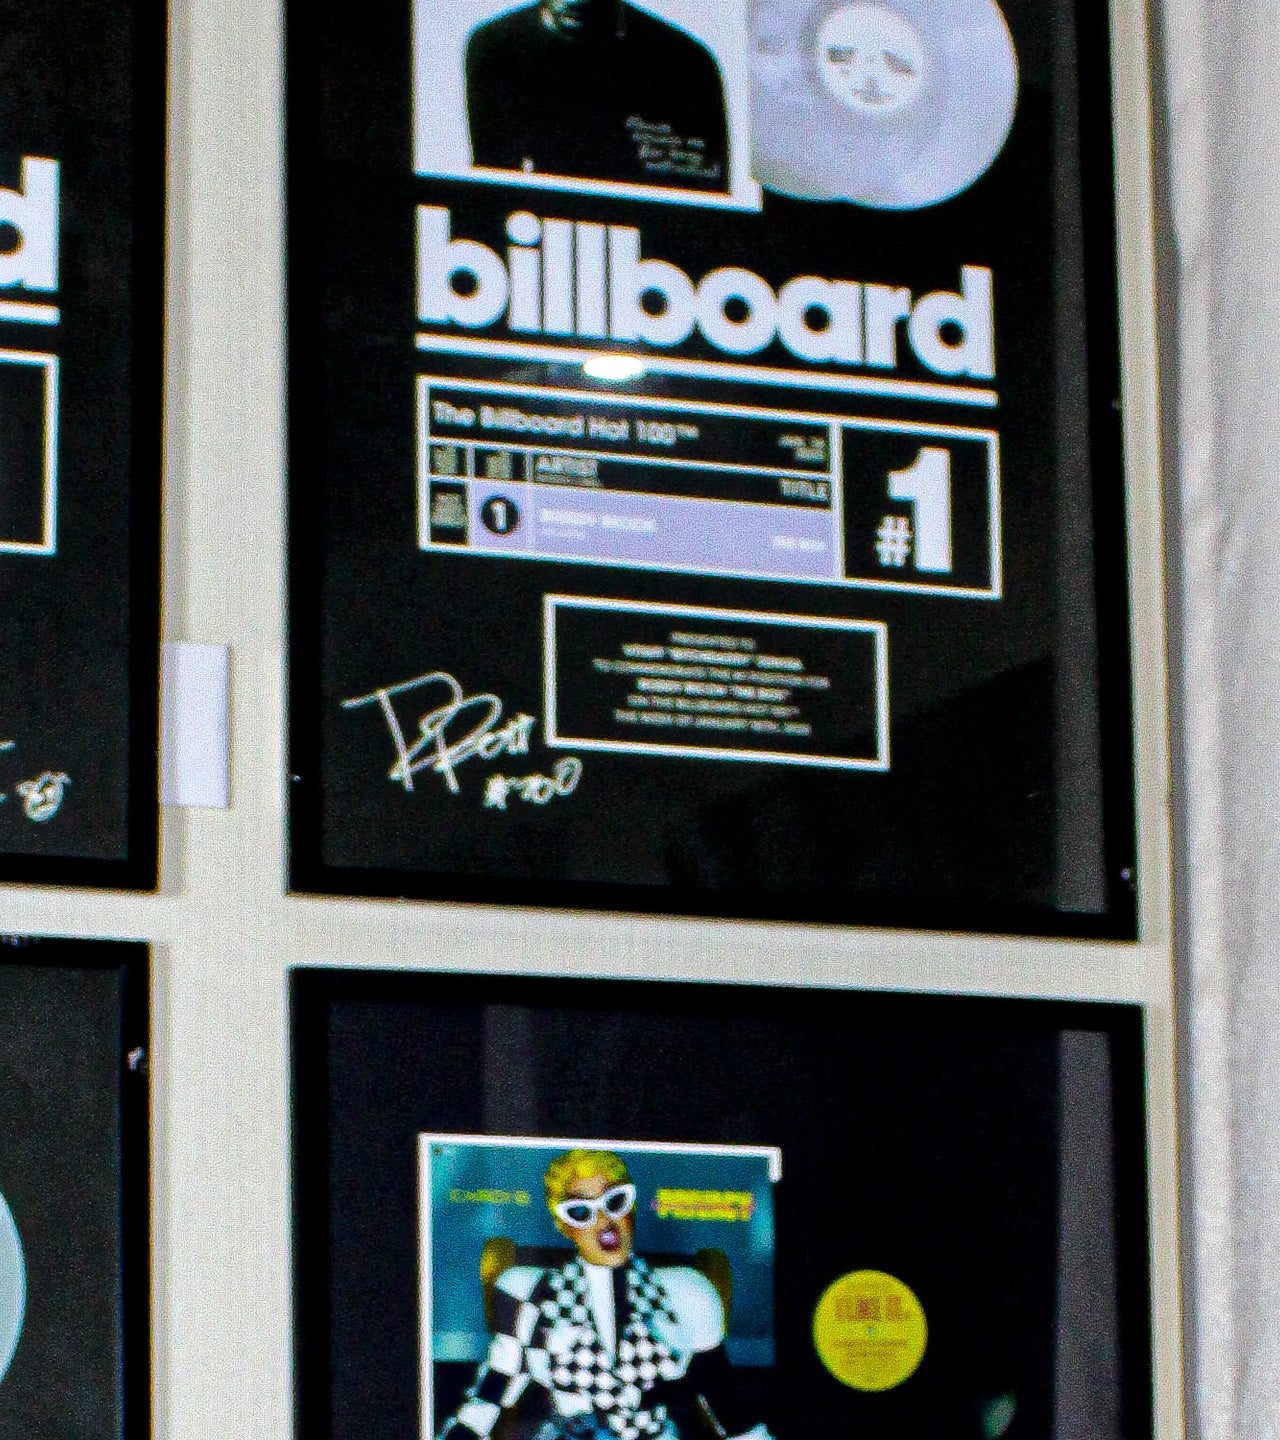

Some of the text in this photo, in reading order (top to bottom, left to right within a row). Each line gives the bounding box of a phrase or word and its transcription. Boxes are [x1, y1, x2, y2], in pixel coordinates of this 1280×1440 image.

[414, 206, 997, 380] billboard
[431, 401, 476, 428] The
[479, 405, 584, 439] Billboard
[589, 416, 630, 442] Hot
[491, 504, 509, 530] 1
[874, 447, 954, 574] #1
